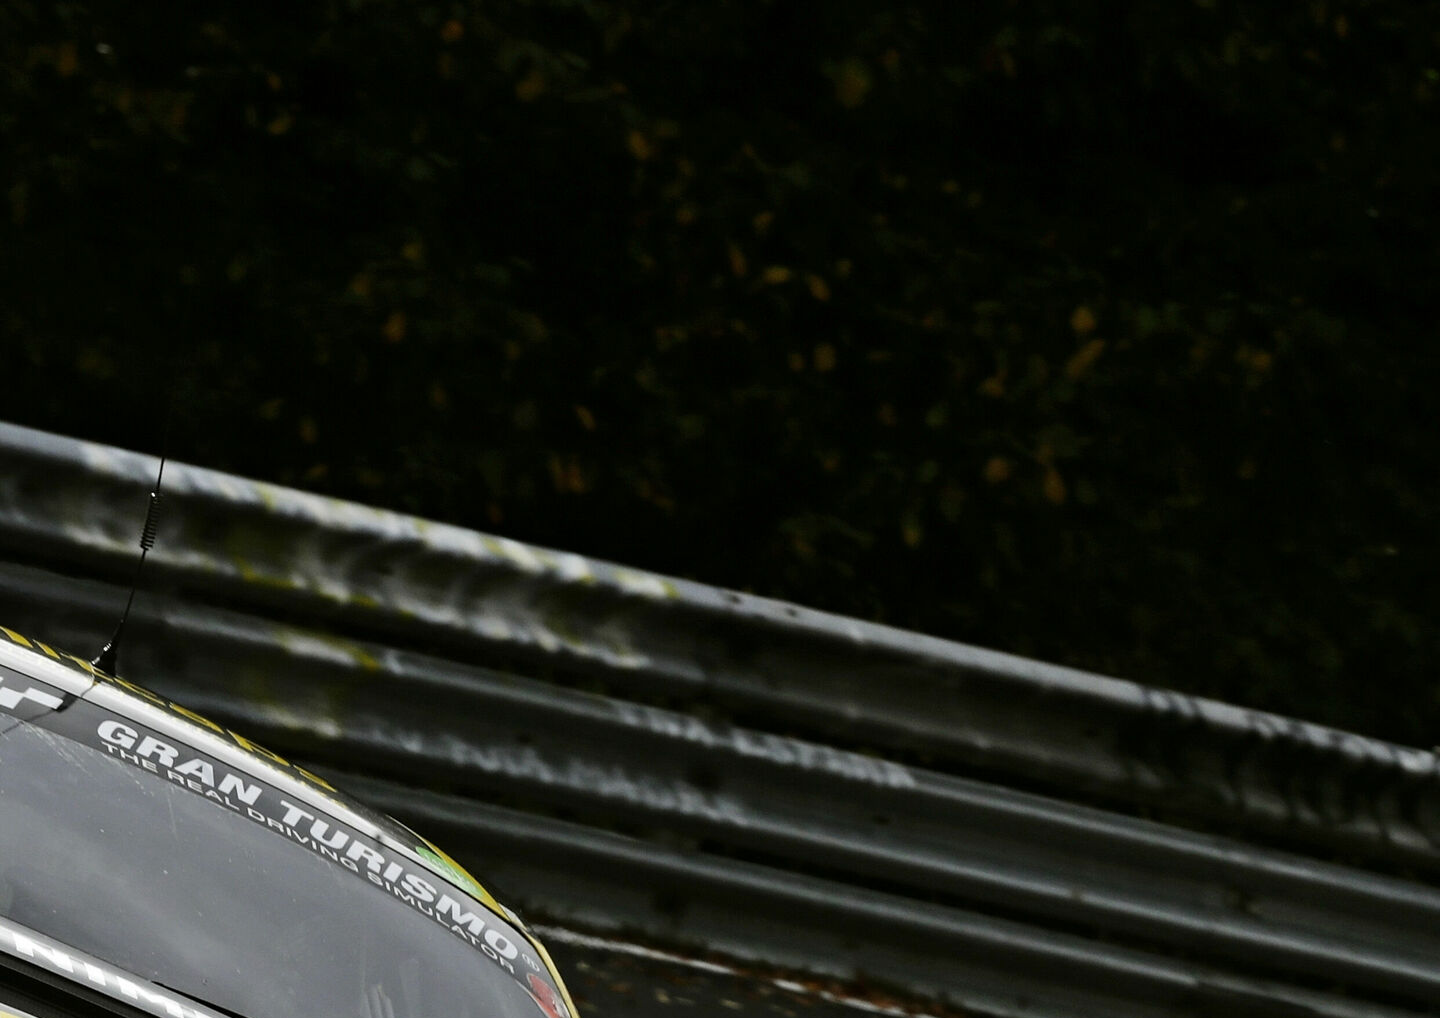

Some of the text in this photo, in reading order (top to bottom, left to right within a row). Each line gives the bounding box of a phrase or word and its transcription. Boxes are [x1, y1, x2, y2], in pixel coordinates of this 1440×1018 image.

[97, 720, 262, 806] GRAN
[280, 800, 518, 960] TURISMO
[101, 741, 158, 774] THE
[166, 769, 240, 812] REAL
[247, 807, 359, 872] DRIVING
[367, 871, 515, 974] SIMULATOR
